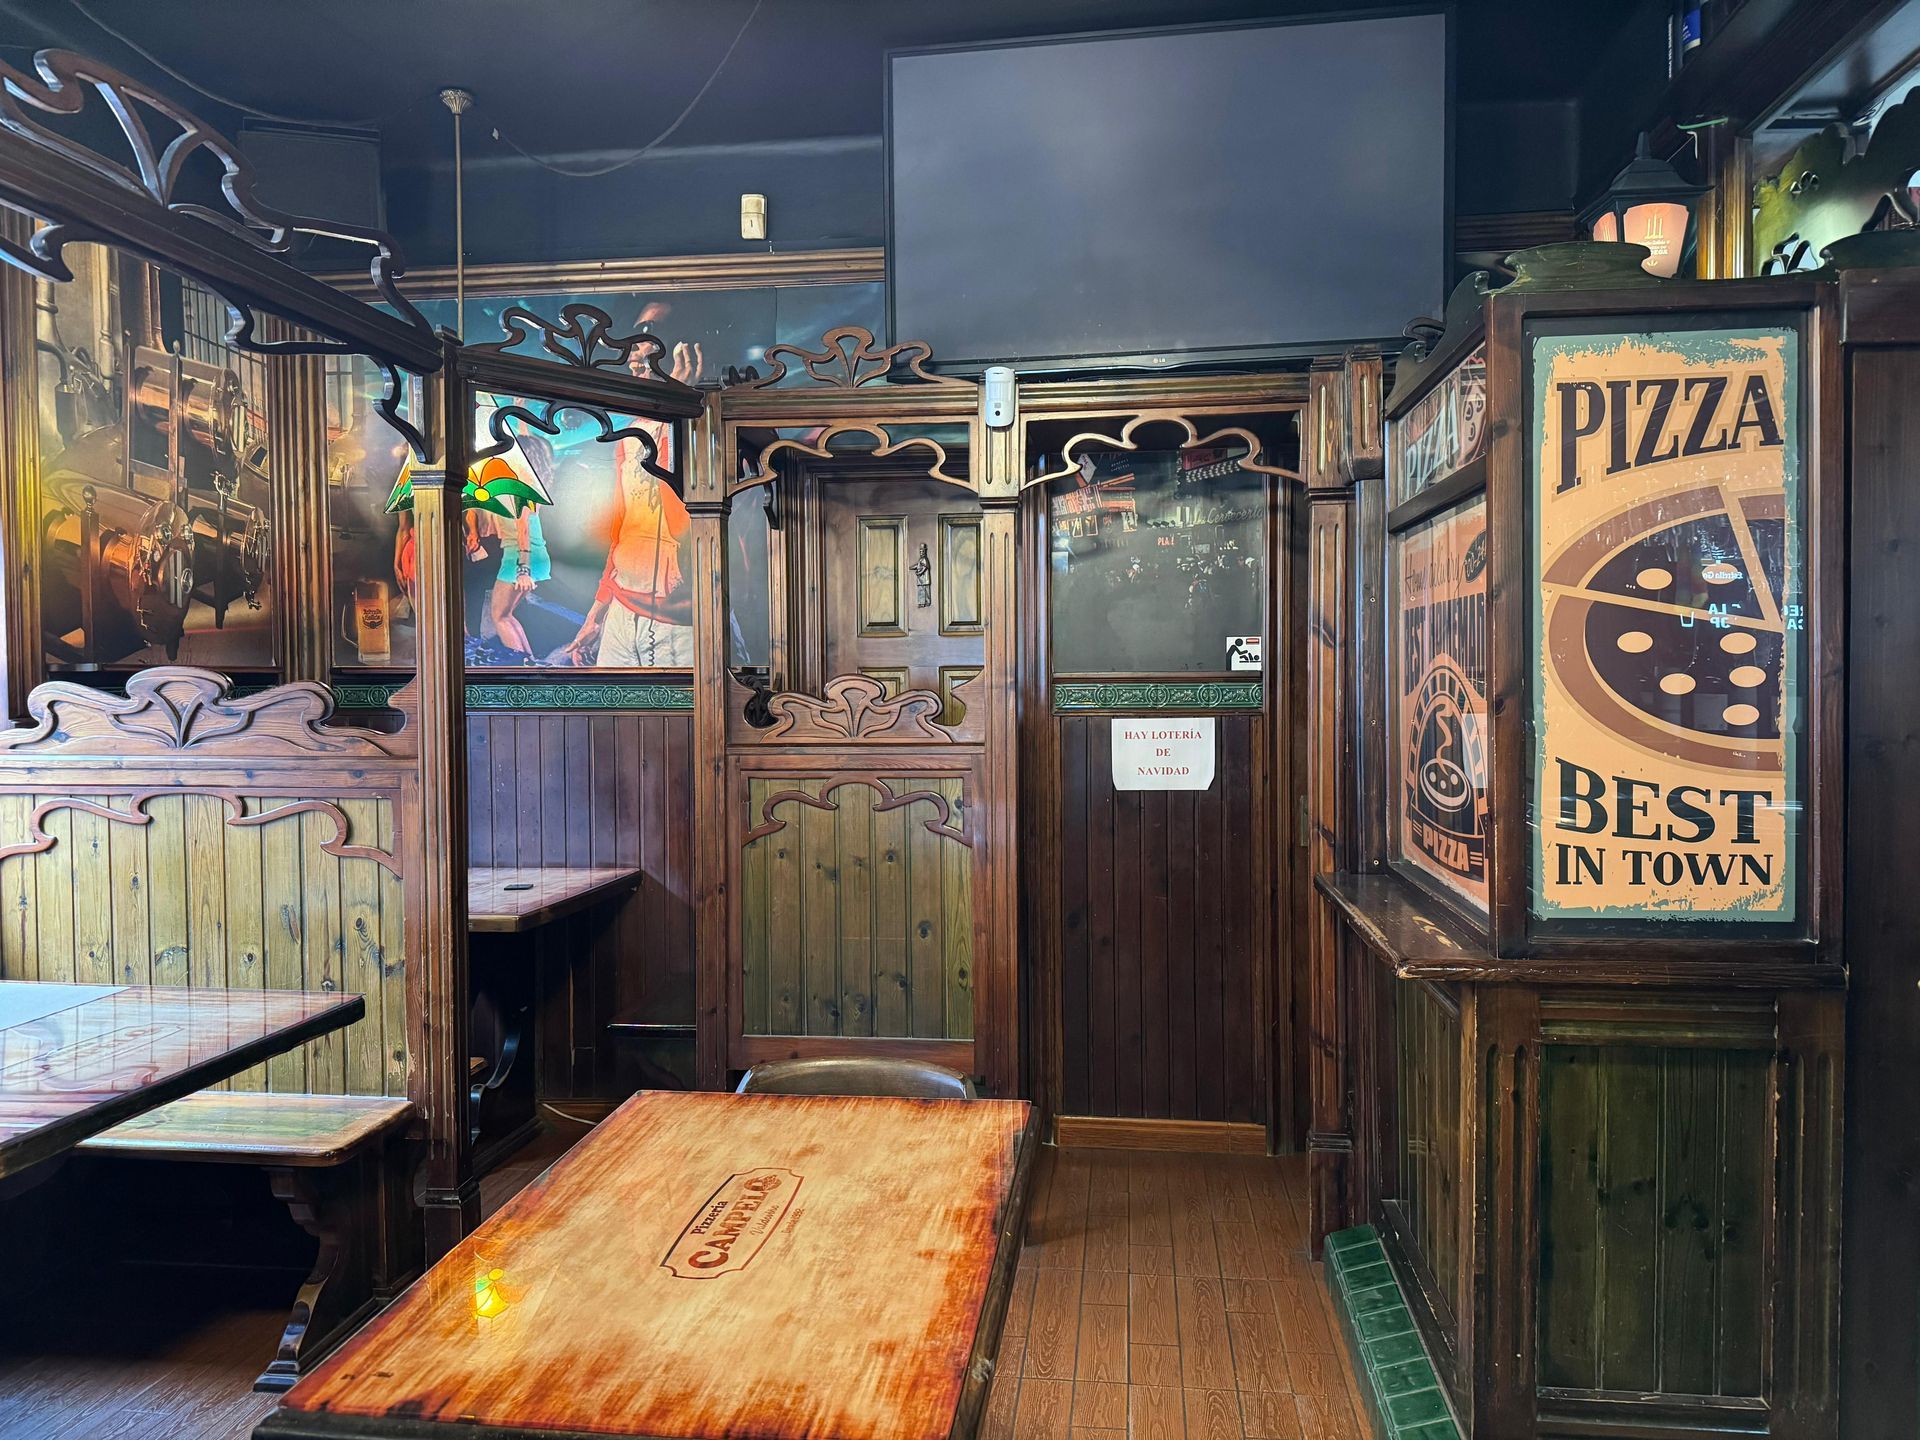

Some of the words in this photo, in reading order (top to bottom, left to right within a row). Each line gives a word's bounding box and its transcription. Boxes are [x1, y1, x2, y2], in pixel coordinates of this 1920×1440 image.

[1406, 388, 1460, 501] PIZZA
[1557, 375, 1784, 495] PIZZA
[1404, 605, 1426, 697] BEST
[1429, 592, 1486, 699] HOMEMAD
[1124, 731, 1148, 740] HAY
[1151, 728, 1202, 740] LOTERÍA
[1156, 748, 1171, 757] DE
[1137, 767, 1190, 776] NAVIDAD
[1555, 756, 1773, 844] BEST
[1422, 823, 1470, 872] PIZZA
[1555, 843, 1606, 885] IN
[1622, 850, 1774, 886] TOWN
[688, 1175, 782, 1269] CAMPELO
[690, 1200, 728, 1235] Pizzeria
